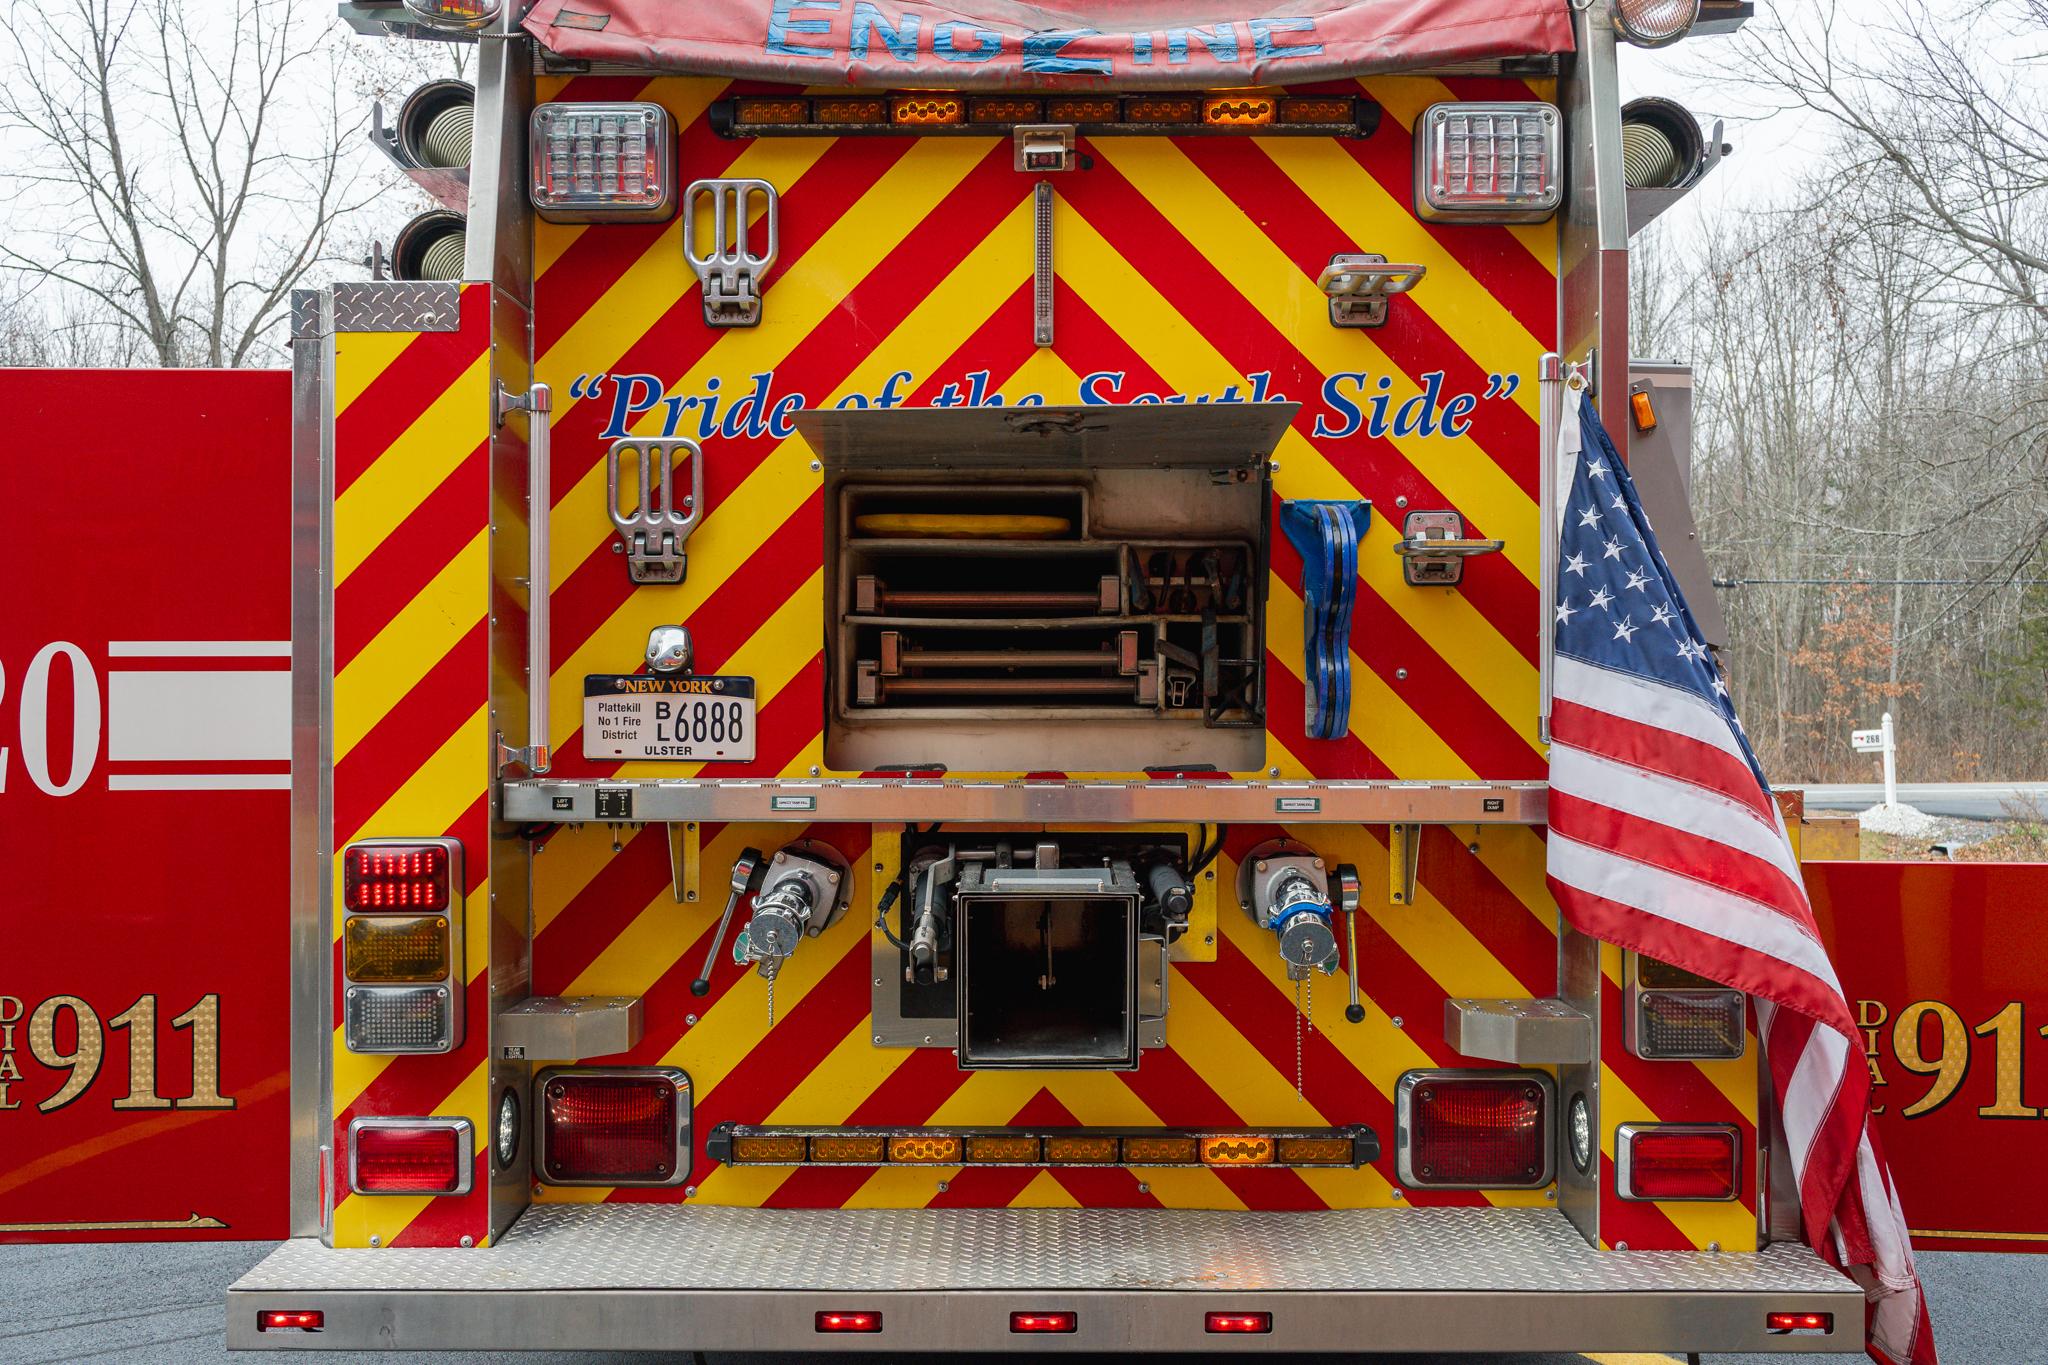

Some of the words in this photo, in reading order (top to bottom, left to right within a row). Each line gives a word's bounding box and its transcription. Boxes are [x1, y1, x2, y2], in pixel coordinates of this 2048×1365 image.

[625, 680, 666, 693] NEW
[669, 680, 713, 694] YORK
[598, 702, 641, 713] Plattekill
[0, 640, 101, 797] 0
[598, 716, 611, 726] No
[613, 716, 619, 726] 1
[623, 716, 641, 727] Fire
[674, 701, 744, 744] 6888
[602, 729, 638, 740] District
[644, 745, 693, 756] ULSTER
[27, 993, 238, 1116] 911
[1892, 999, 2048, 1121] 91
